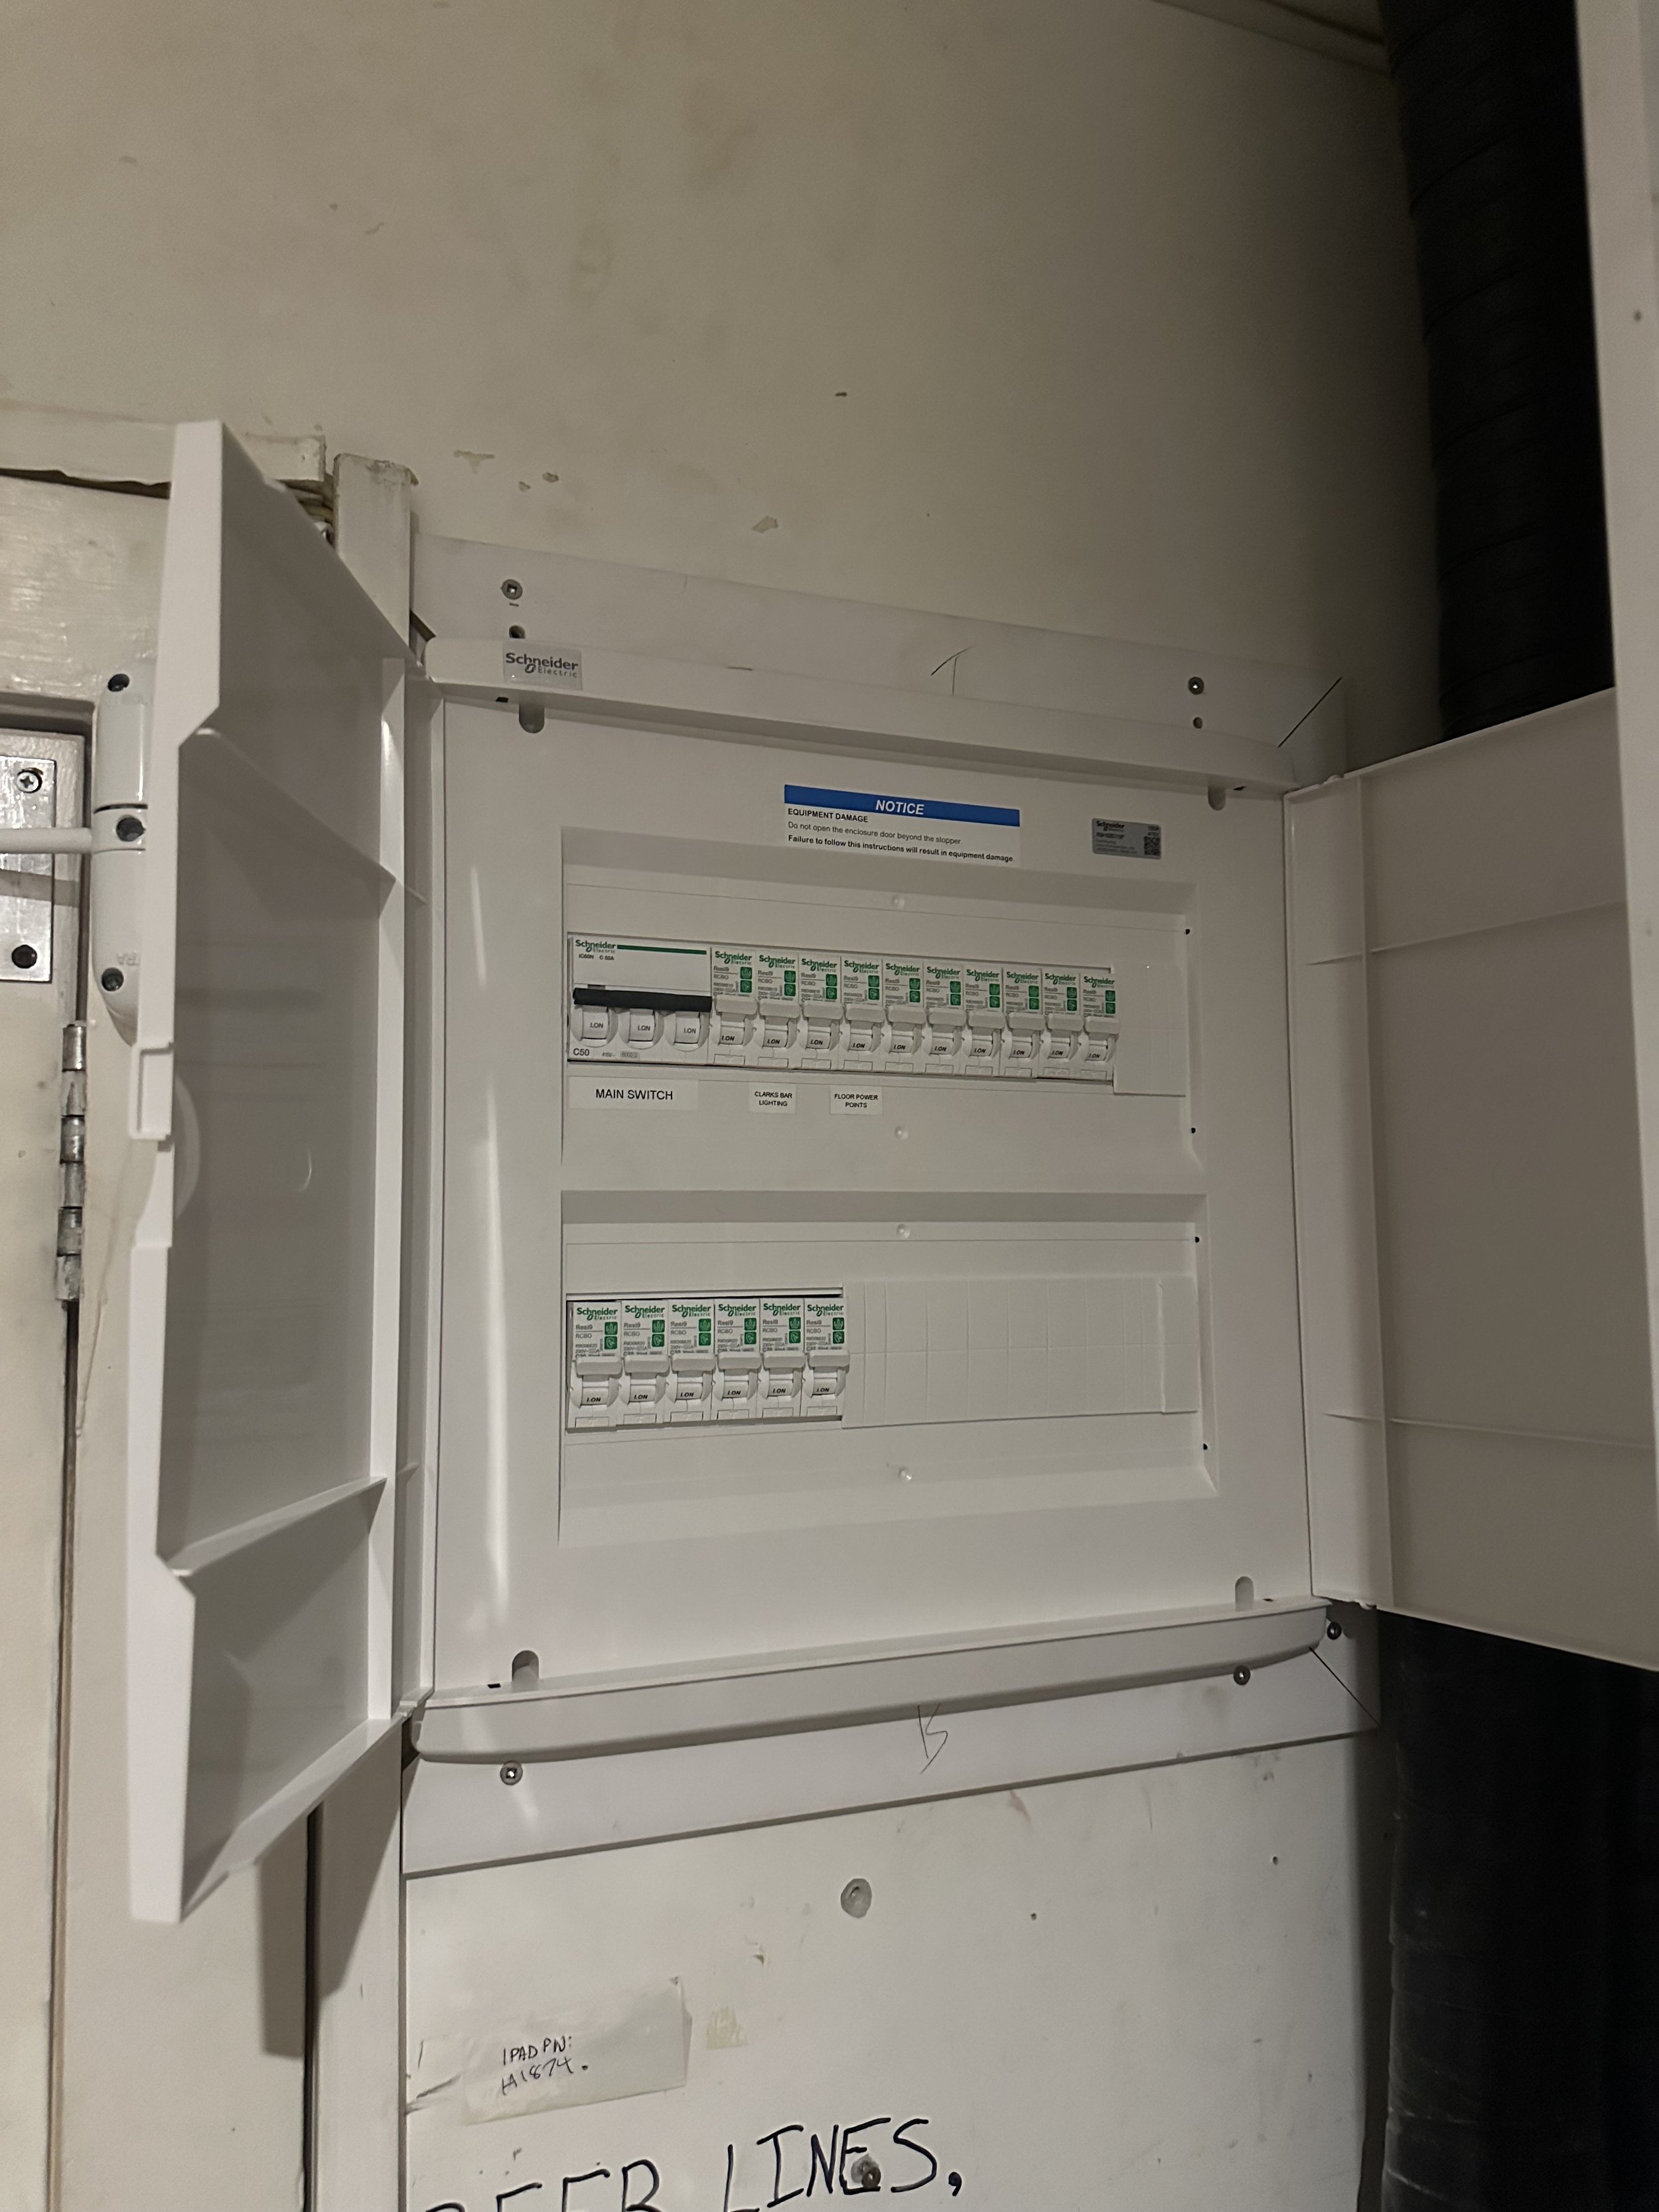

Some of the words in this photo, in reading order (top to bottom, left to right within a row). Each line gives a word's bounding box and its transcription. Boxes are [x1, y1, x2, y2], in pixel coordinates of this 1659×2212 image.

[506, 652, 579, 673] Schneider
[538, 666, 577, 678] Electric
[876, 799, 924, 815] NOTICE
[788, 808, 833, 820] EQUIPMENT
[835, 813, 868, 823] DAMAGE
[845, 828, 878, 837] enclosure
[897, 832, 922, 842] beyond
[788, 835, 814, 844] Failure
[824, 838, 846, 847] follow
[863, 842, 904, 853] instructions
[949, 849, 984, 860] equipment
[575, 939, 616, 952] Schneider
[715, 951, 752, 964] Schneider
[759, 955, 795, 968] Schneider
[802, 958, 837, 971] Schneider
[844, 960, 879, 973] Schneider
[886, 963, 920, 976] Schneider
[927, 966, 960, 978] Schneider
[967, 970, 999, 981] Schneider
[1007, 972, 1039, 984] Schneider
[1045, 973, 1076, 985] Schneider
[1084, 977, 1115, 988] Schneider
[596, 1089, 624, 1100] MAIN
[627, 1090, 673, 1100] SWITCH
[577, 1307, 618, 1321] Schneider
[625, 1305, 665, 1318] Schneider
[672, 1303, 711, 1317] Schneider
[718, 1304, 757, 1317] Schneider
[763, 1303, 801, 1316] Schneider
[808, 1305, 843, 1317] Schneider
[503, 2045, 538, 2065] IPAD
[426, 2159, 662, 2212] ER
